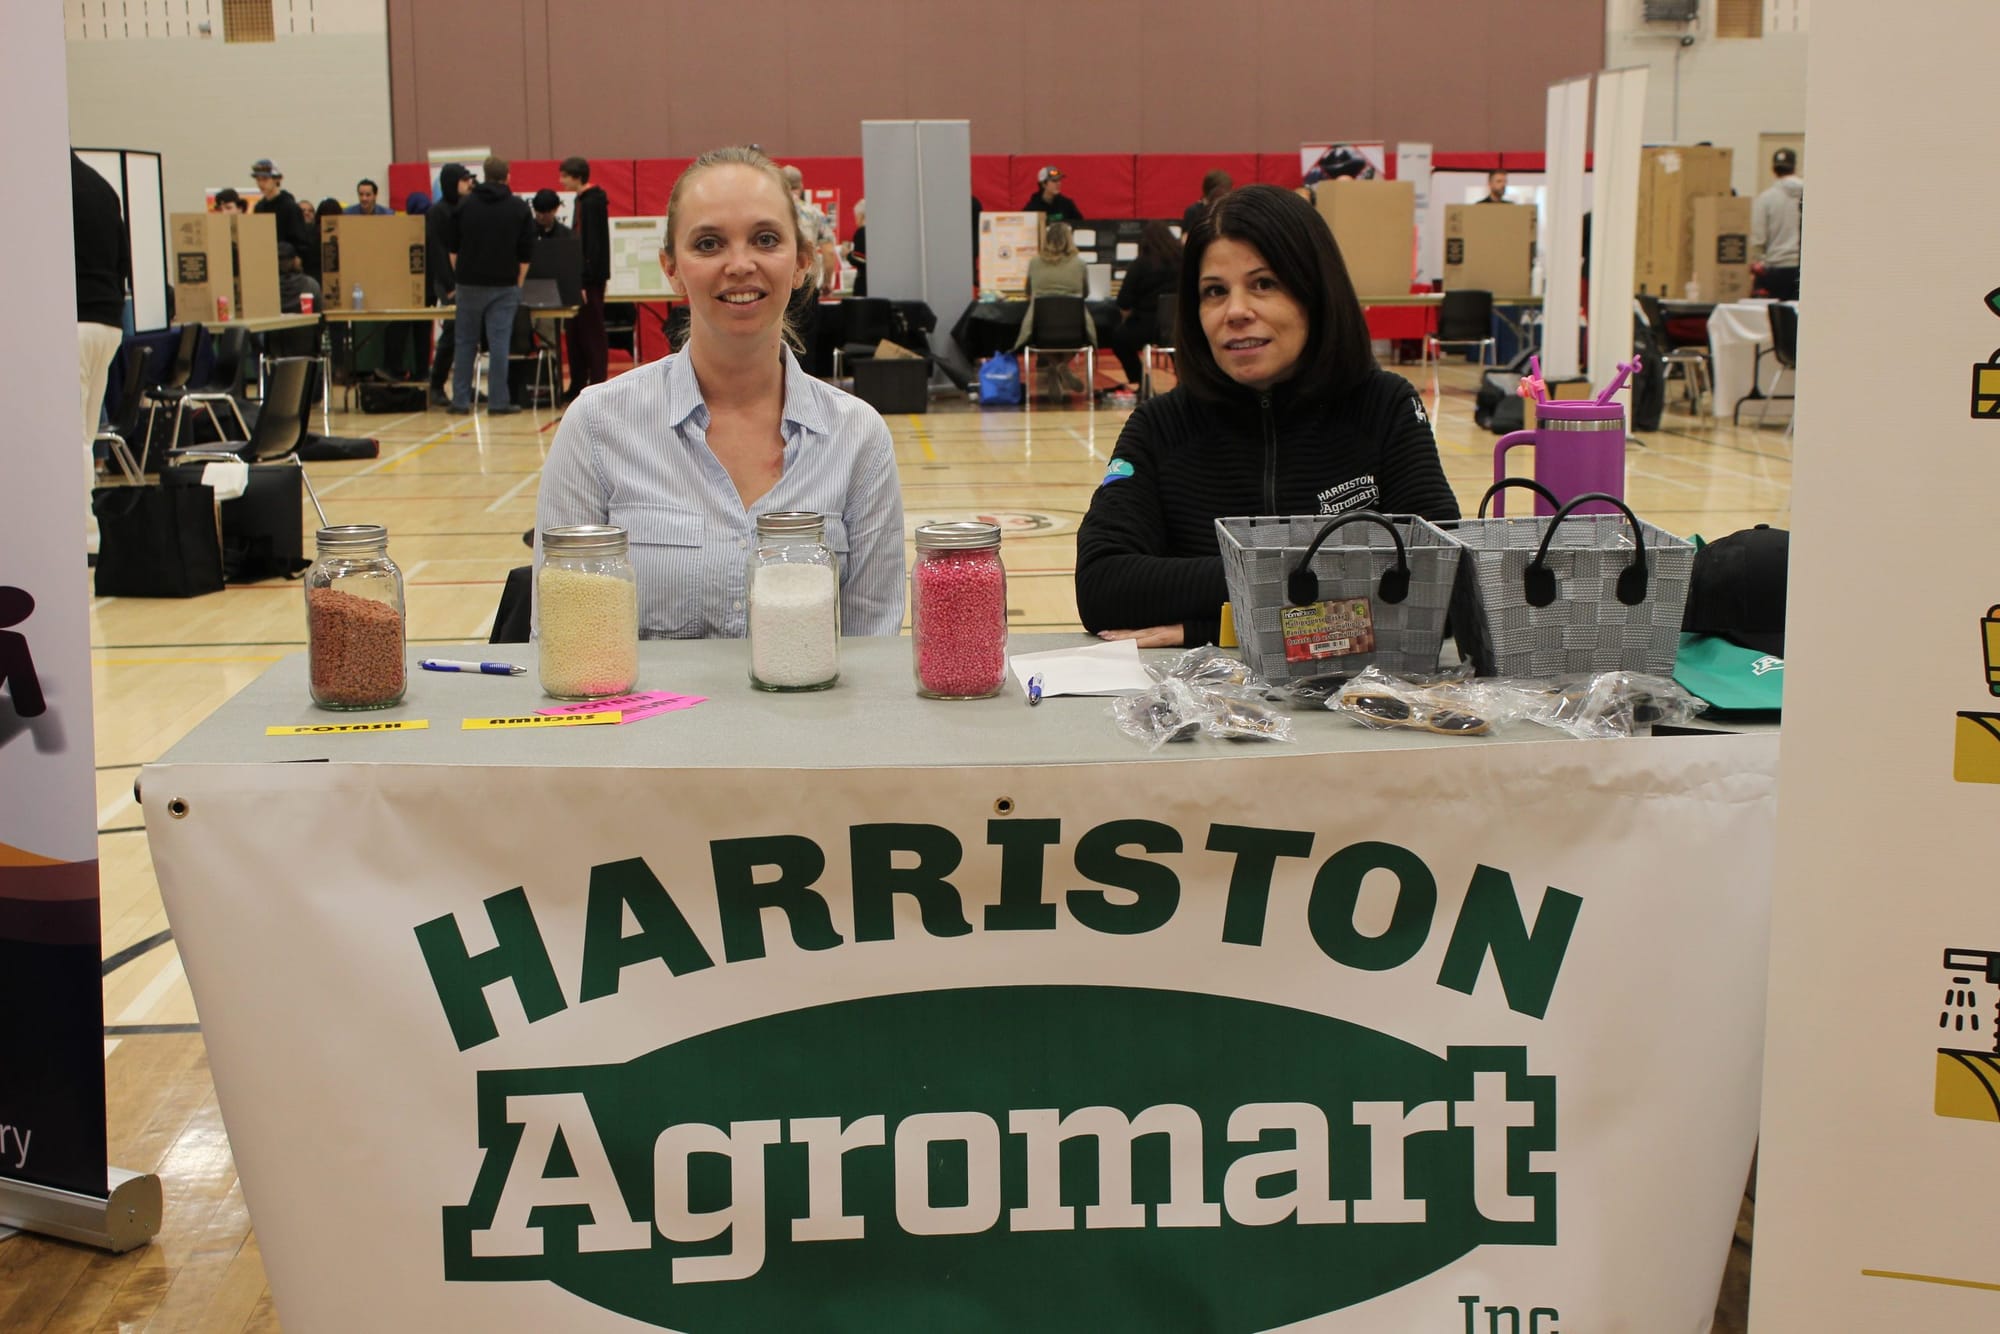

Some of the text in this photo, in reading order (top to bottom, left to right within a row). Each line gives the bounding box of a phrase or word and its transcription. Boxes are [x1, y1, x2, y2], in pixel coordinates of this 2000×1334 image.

[1317, 475, 1374, 501] HARRISTON
[1322, 487, 1377, 514] Agromart
[295, 722, 401, 733] POTASH
[413, 817, 1584, 1052] HARRISTON
[471, 1070, 1536, 1285] Agromart
